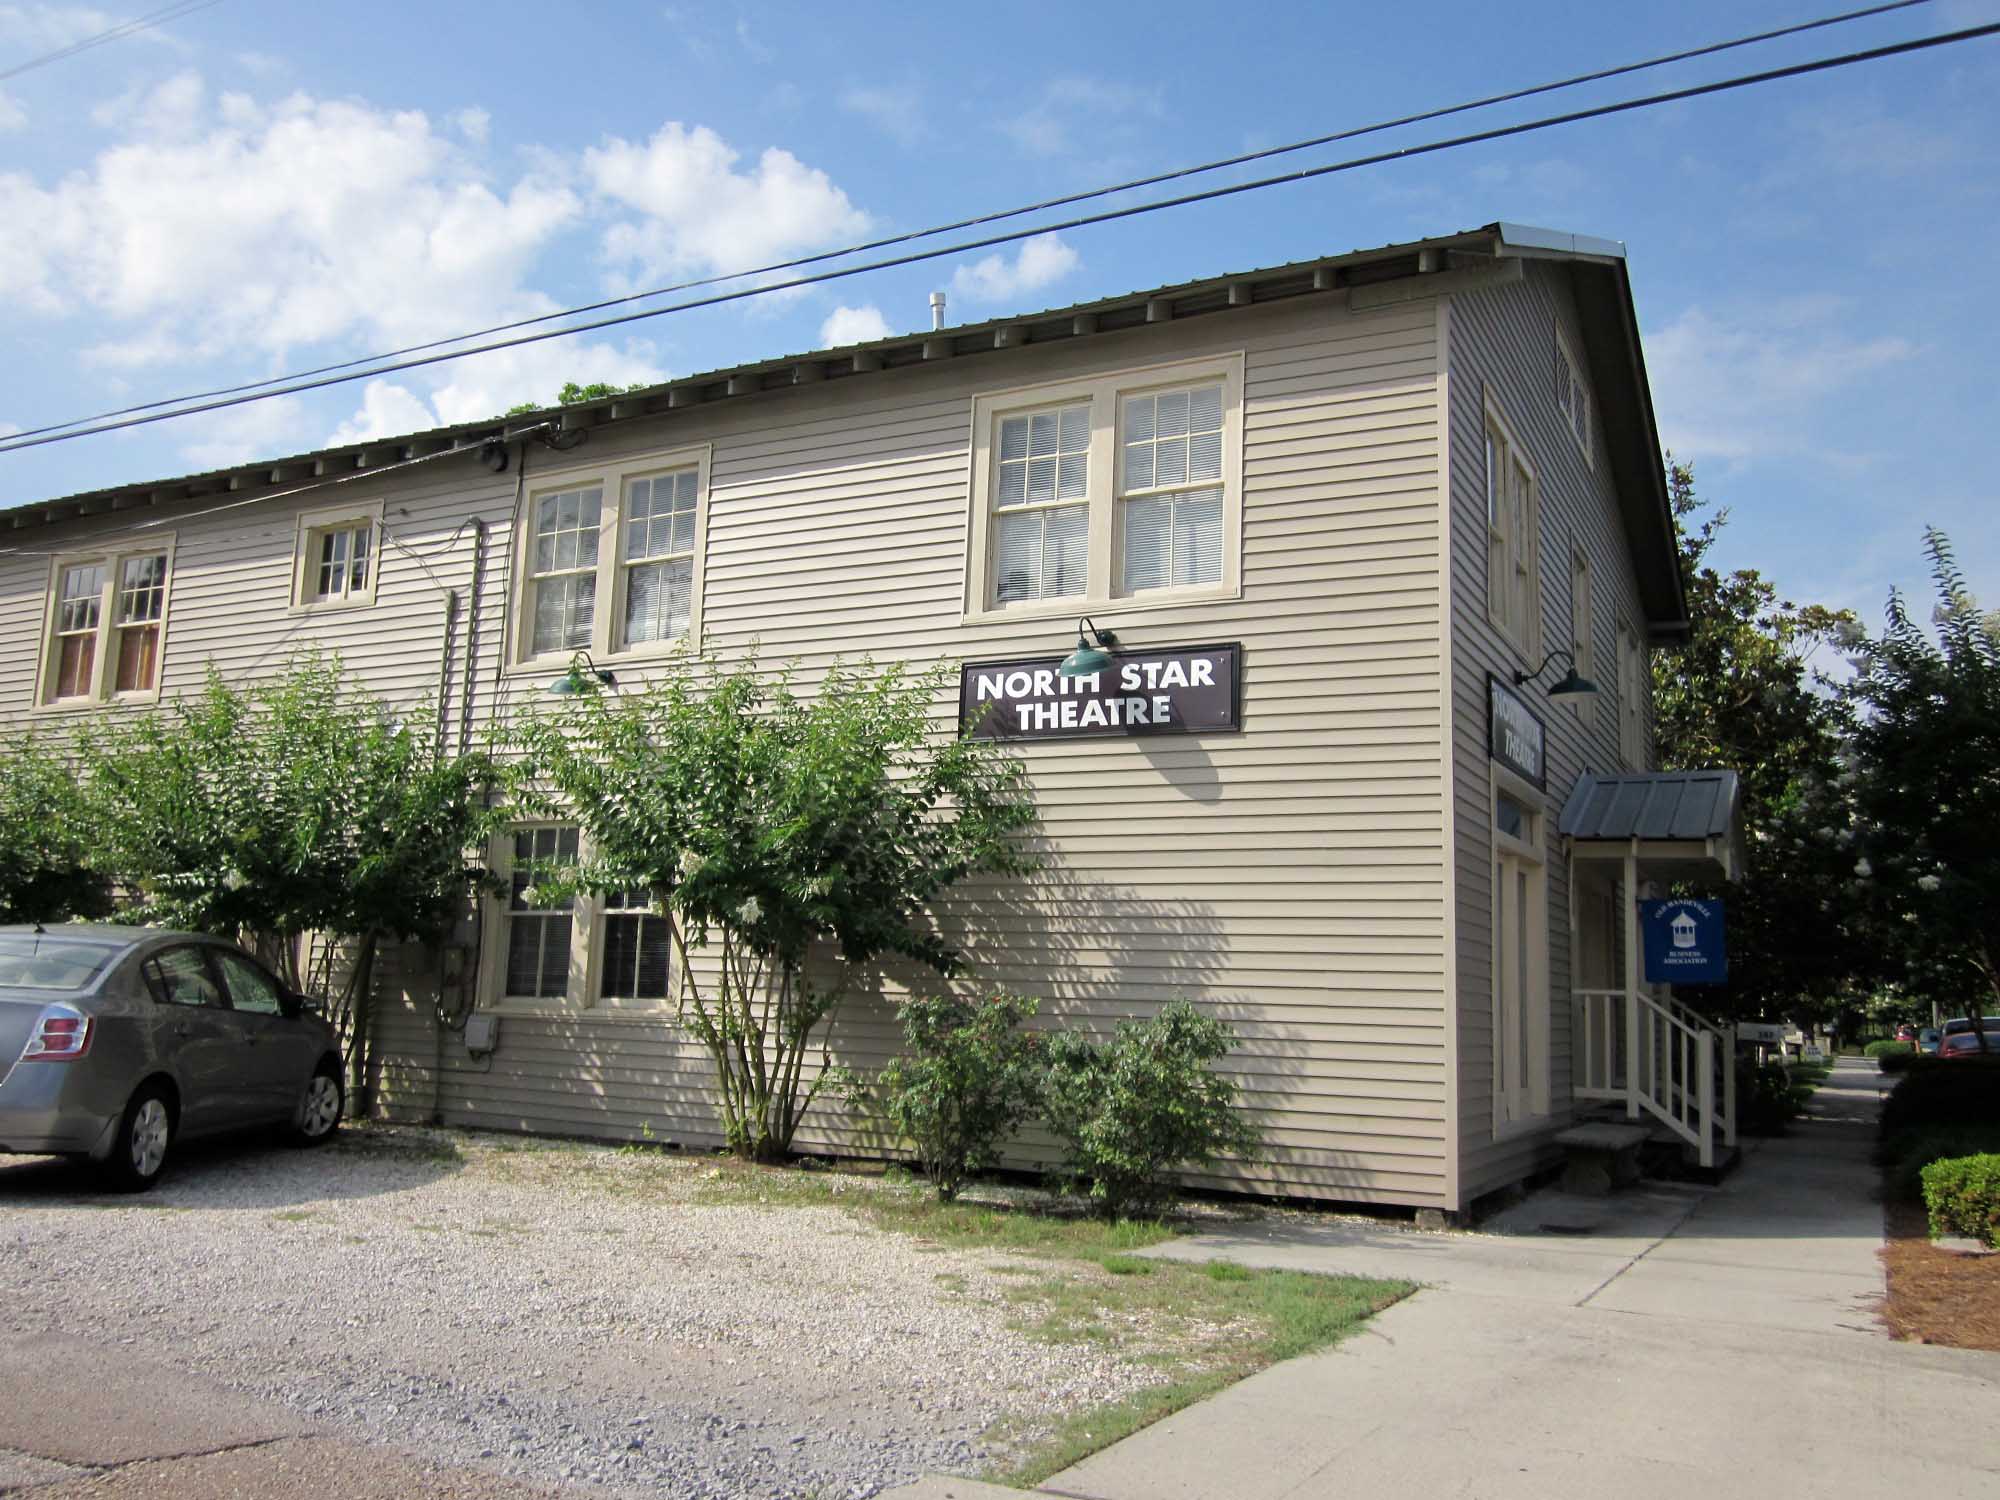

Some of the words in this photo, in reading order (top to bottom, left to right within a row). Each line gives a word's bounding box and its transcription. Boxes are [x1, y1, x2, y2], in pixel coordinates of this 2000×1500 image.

[976, 668, 1099, 700] NORTH
[1120, 659, 1216, 690] STAR
[1015, 696, 1171, 731] THEATRE
